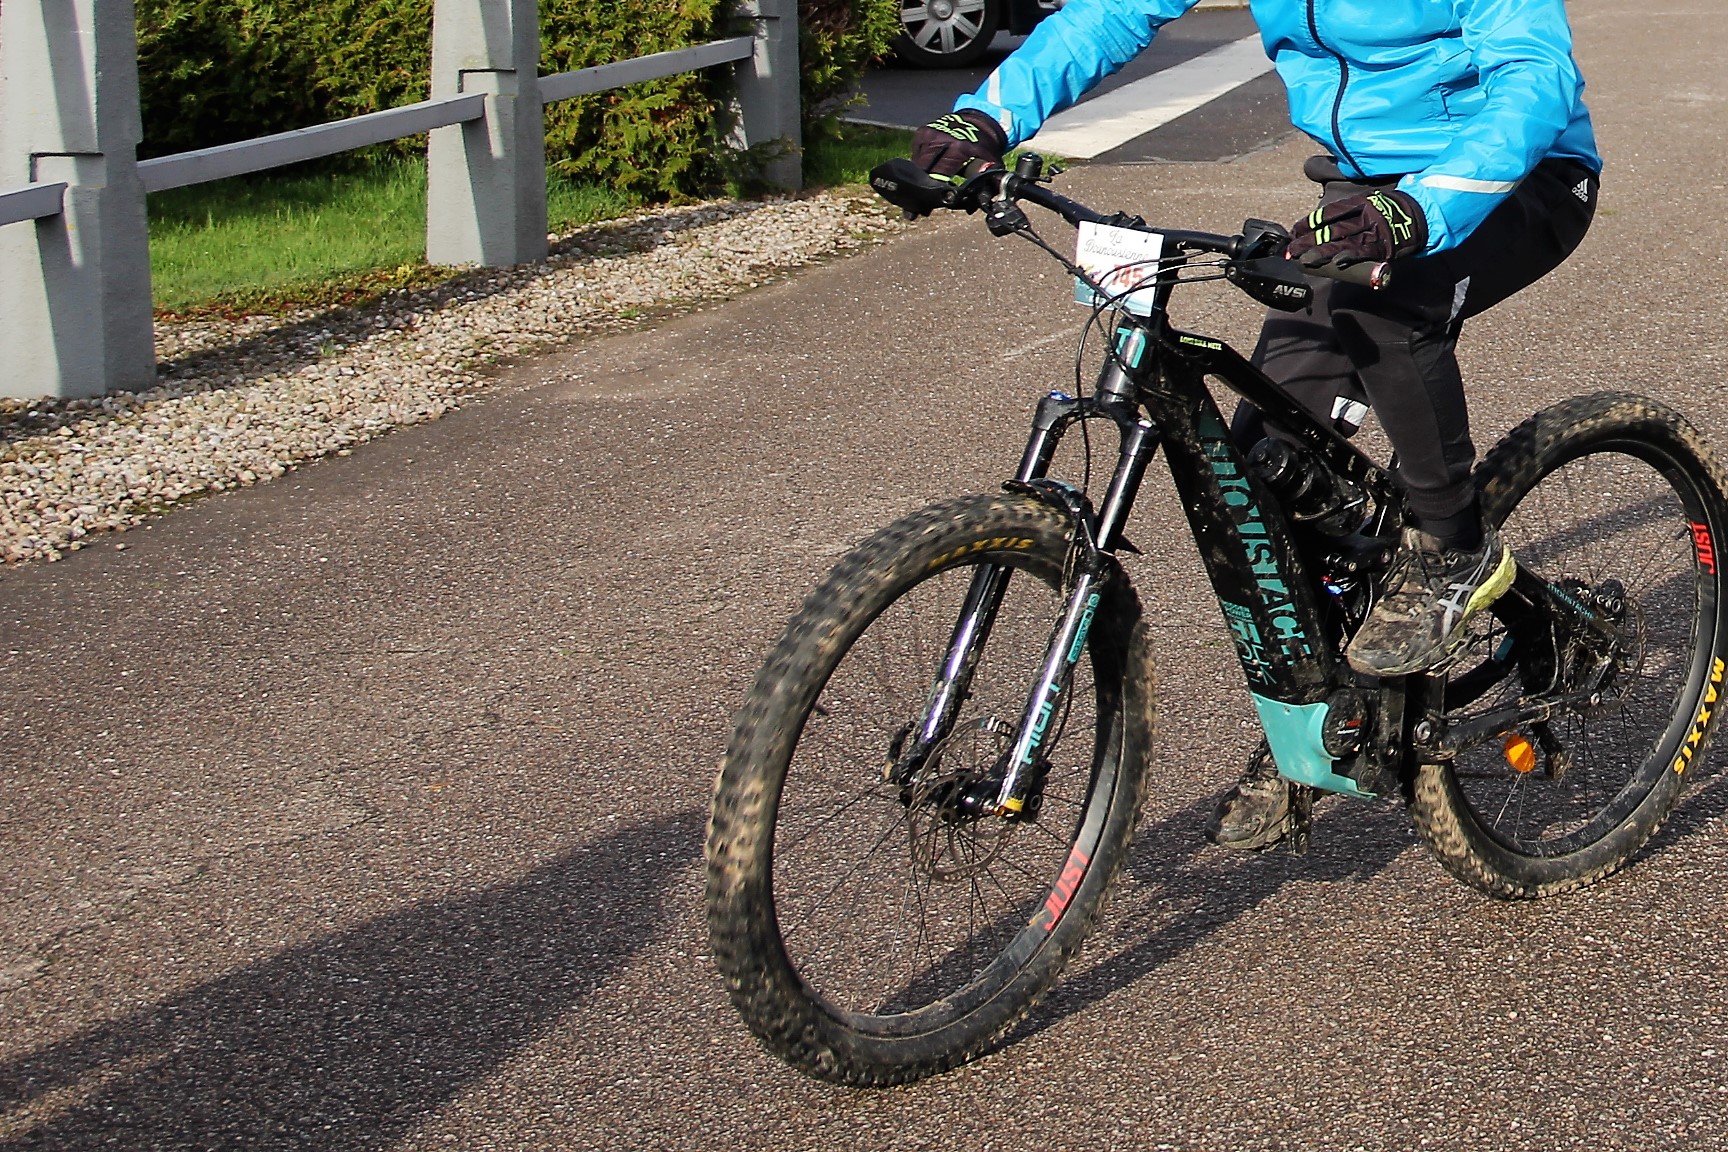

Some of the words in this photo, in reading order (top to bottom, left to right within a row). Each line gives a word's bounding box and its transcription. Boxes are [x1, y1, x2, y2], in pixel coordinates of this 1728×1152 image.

[1109, 230, 1123, 246] La
[1111, 263, 1144, 289] 745
[1691, 520, 1717, 575] JUST
[1673, 655, 1725, 776] MAXXIS
[1043, 842, 1090, 932] JUST
